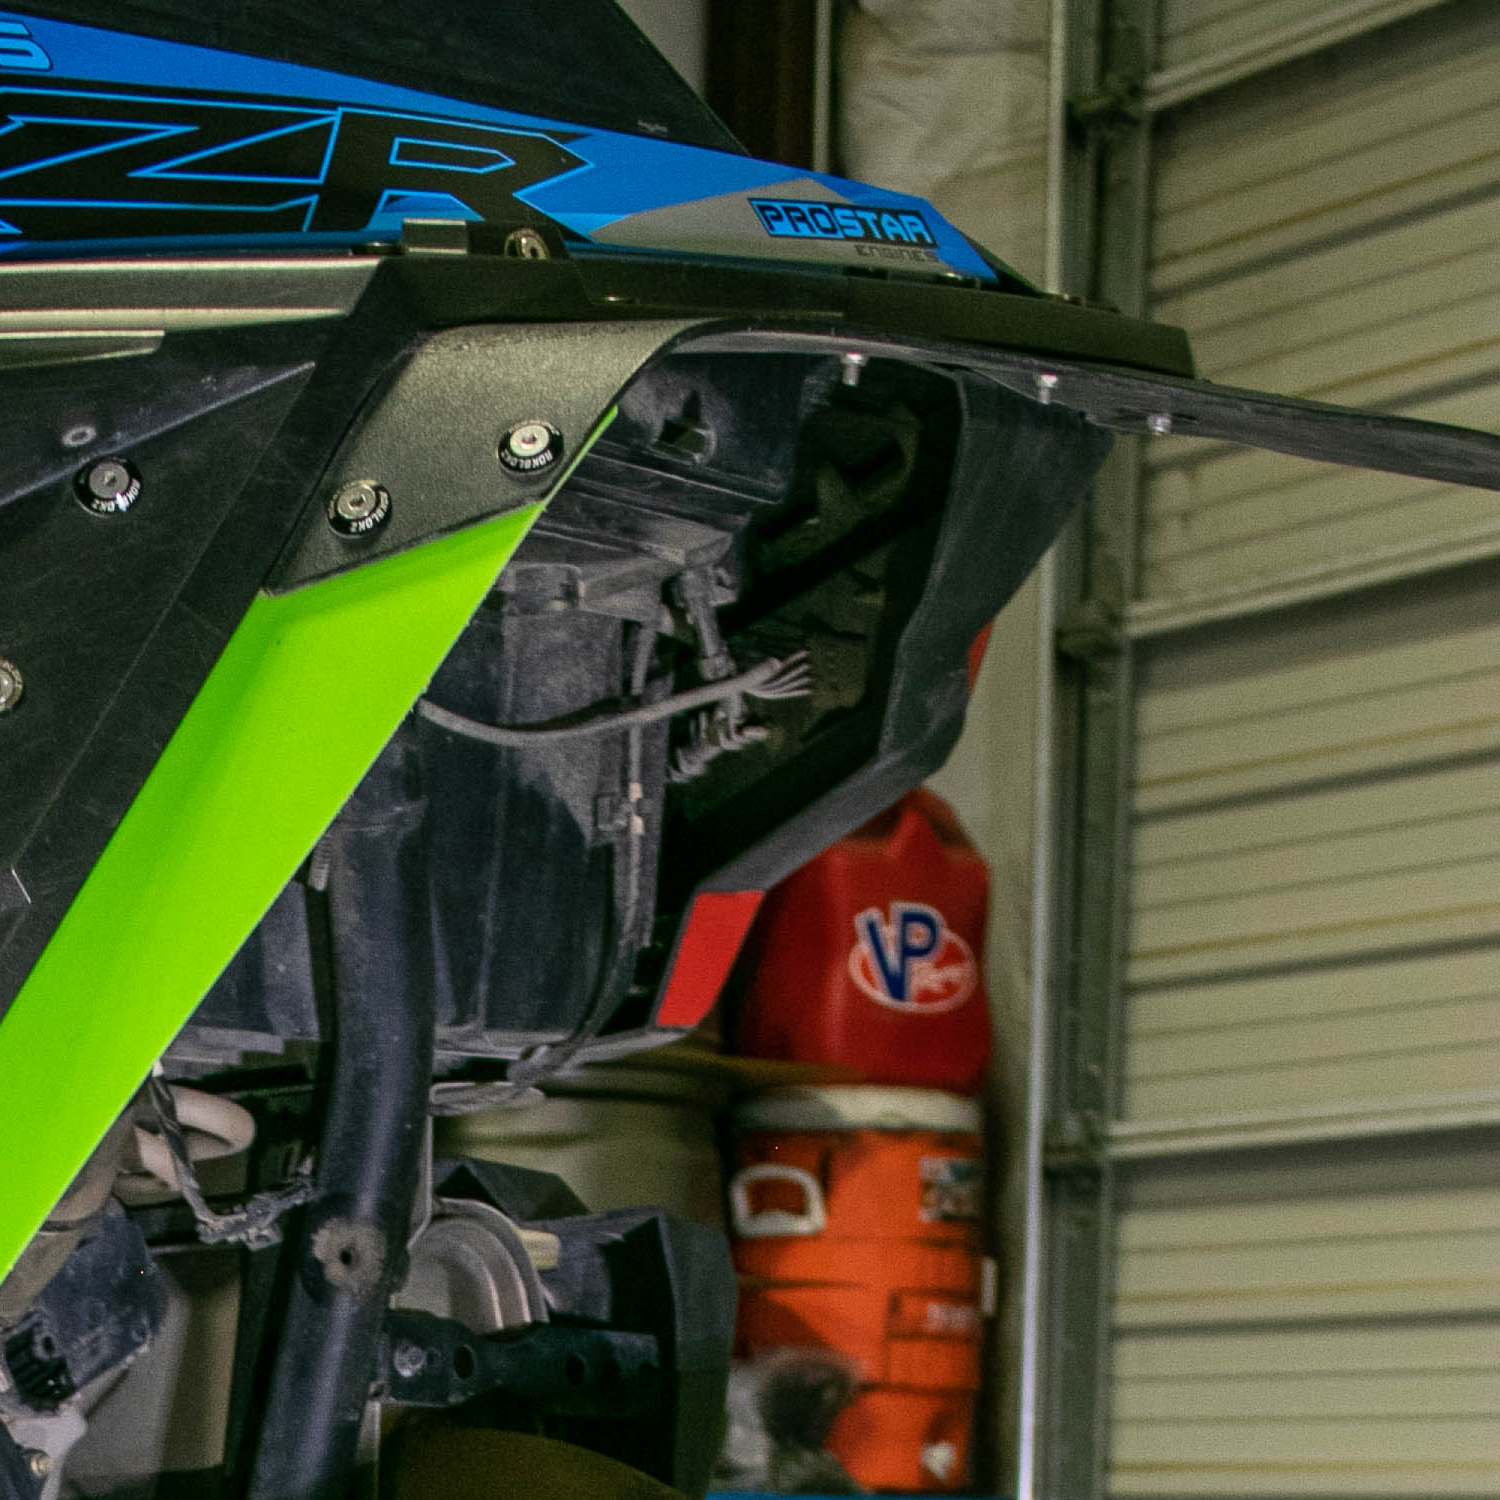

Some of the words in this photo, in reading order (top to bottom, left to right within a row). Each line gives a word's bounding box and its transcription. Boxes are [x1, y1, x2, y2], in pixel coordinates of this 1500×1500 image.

[754, 201, 935, 246] PROSTAR
[854, 244, 940, 263] ENGINES
[861, 908, 940, 1003] VP
